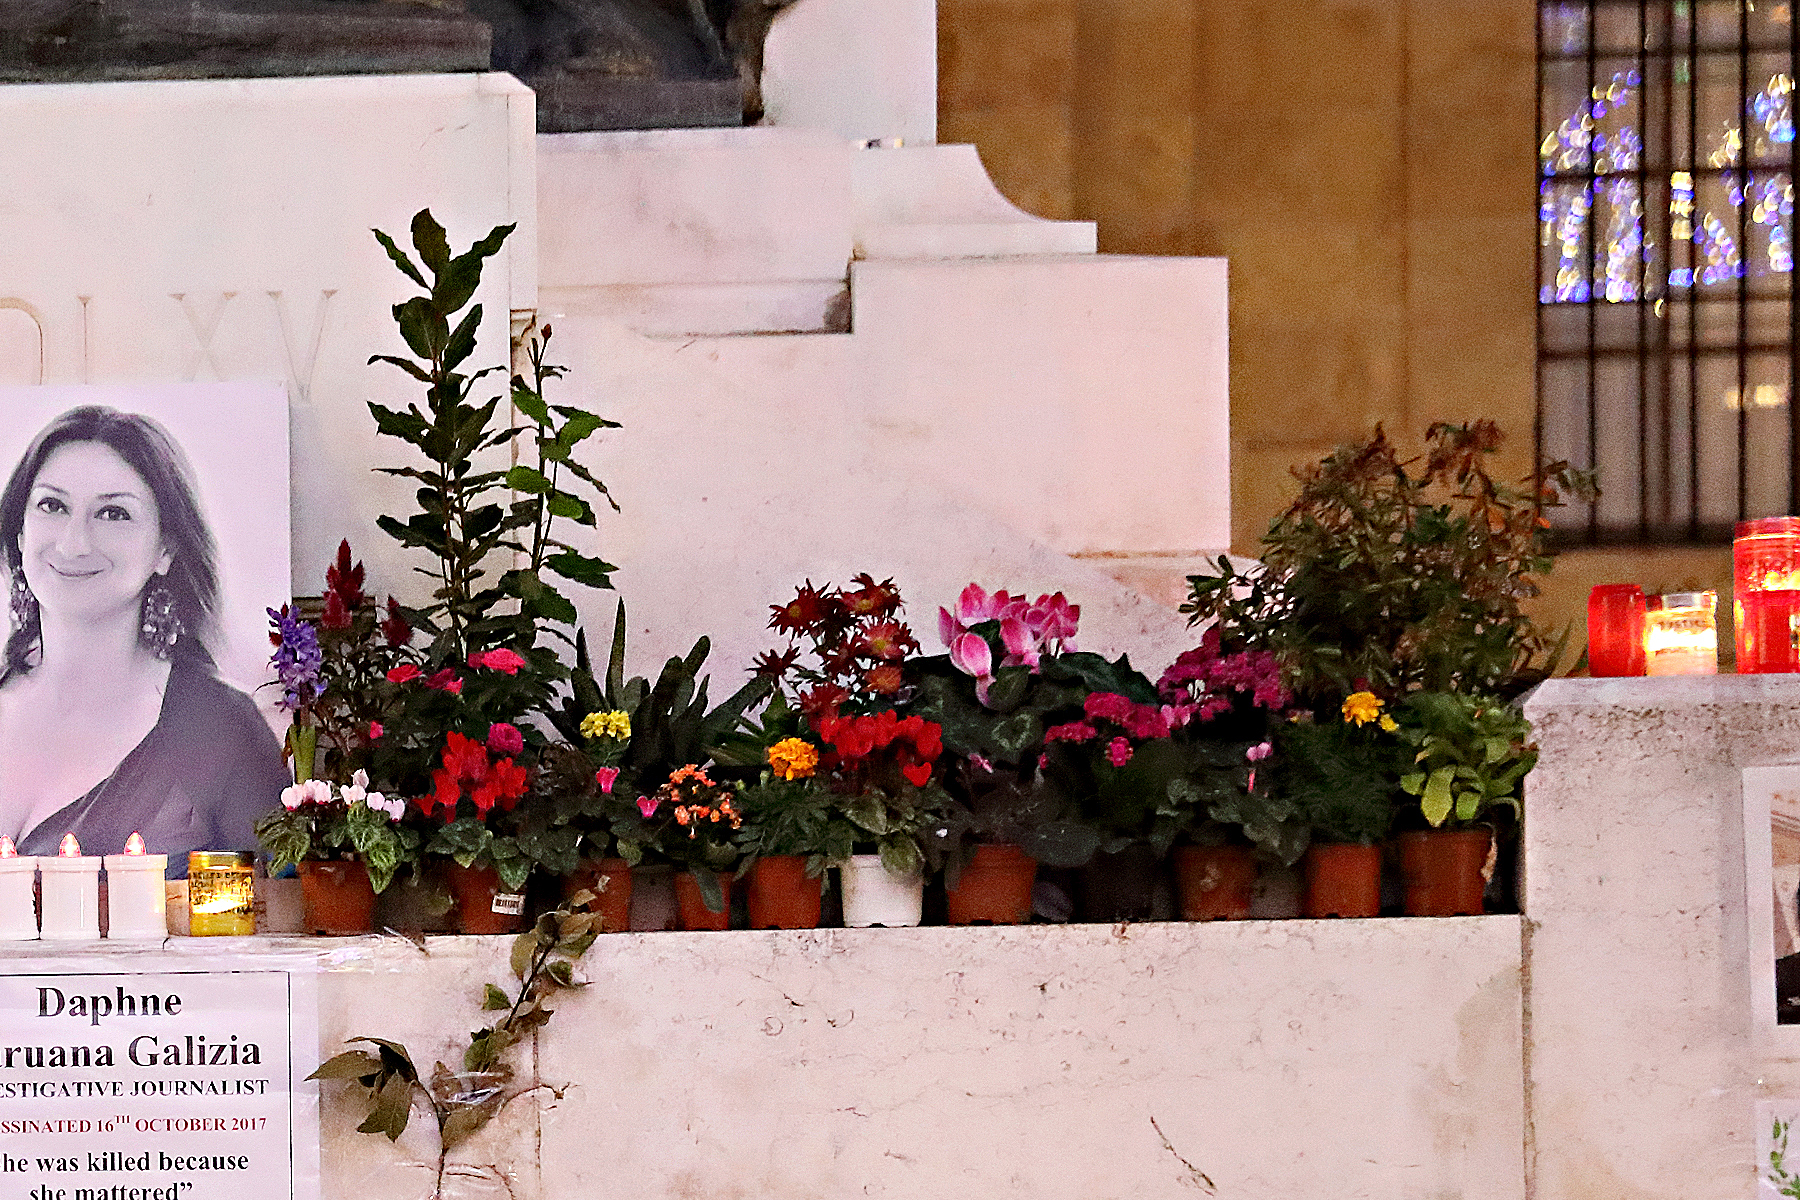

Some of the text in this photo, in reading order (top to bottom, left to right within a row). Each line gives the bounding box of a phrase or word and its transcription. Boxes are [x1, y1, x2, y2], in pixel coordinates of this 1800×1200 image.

[36, 986, 182, 1025] Daphne
[127, 1034, 262, 1067] Galizia
[130, 1078, 270, 1098] JOURNALIST
[135, 1117, 227, 1134] OCTOBER
[231, 1117, 268, 1132] 2017
[36, 1157, 79, 1173] was
[87, 1151, 151, 1173] killed
[158, 1151, 250, 1172] because
